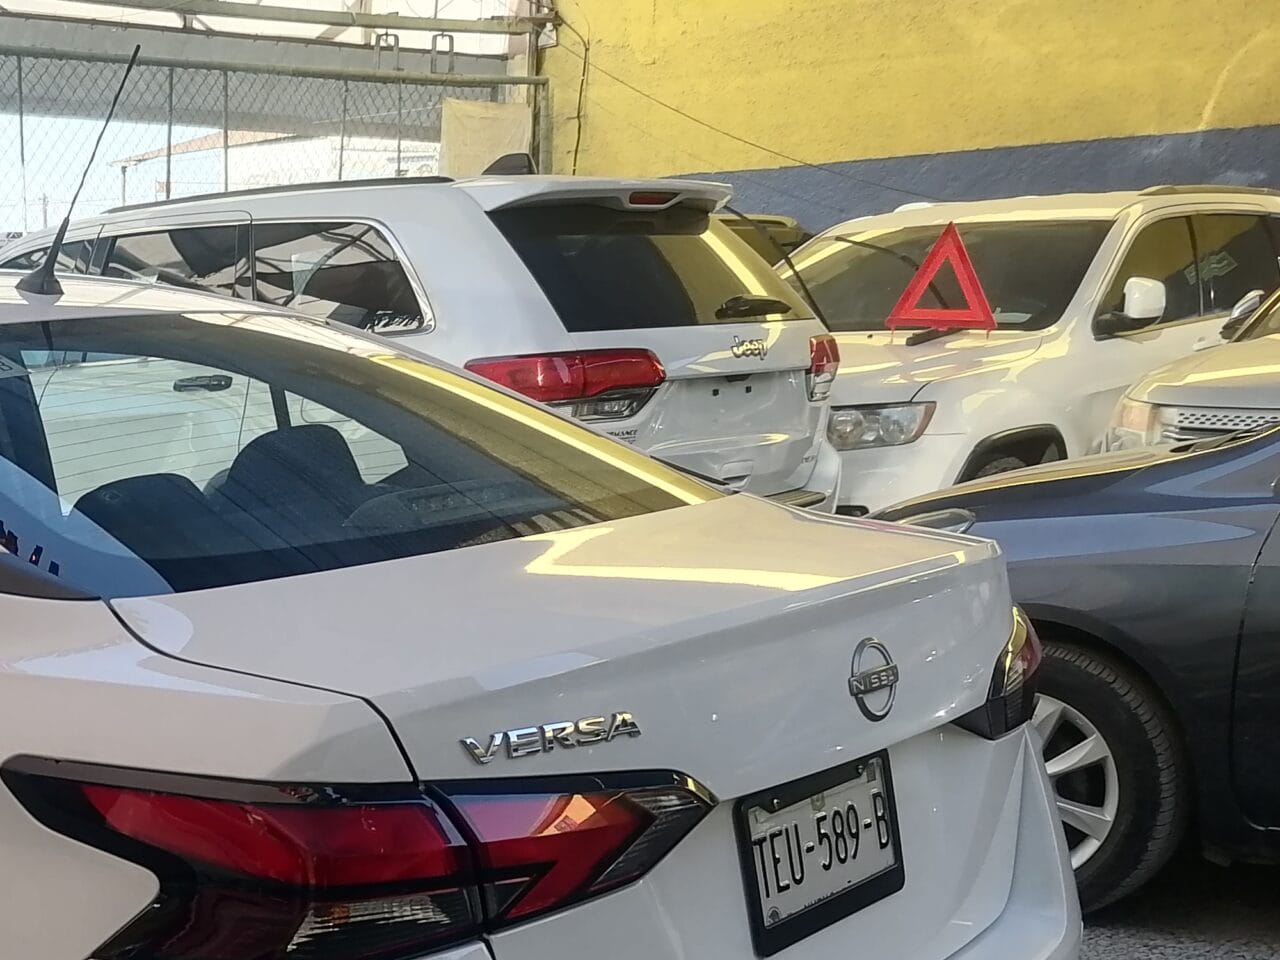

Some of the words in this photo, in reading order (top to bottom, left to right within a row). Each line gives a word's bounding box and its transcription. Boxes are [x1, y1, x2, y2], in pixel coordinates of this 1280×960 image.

[731, 335, 768, 361] Jeep
[852, 668, 897, 693] NISSA
[459, 710, 642, 765] VERSA
[751, 789, 890, 899] TEU-589-B
